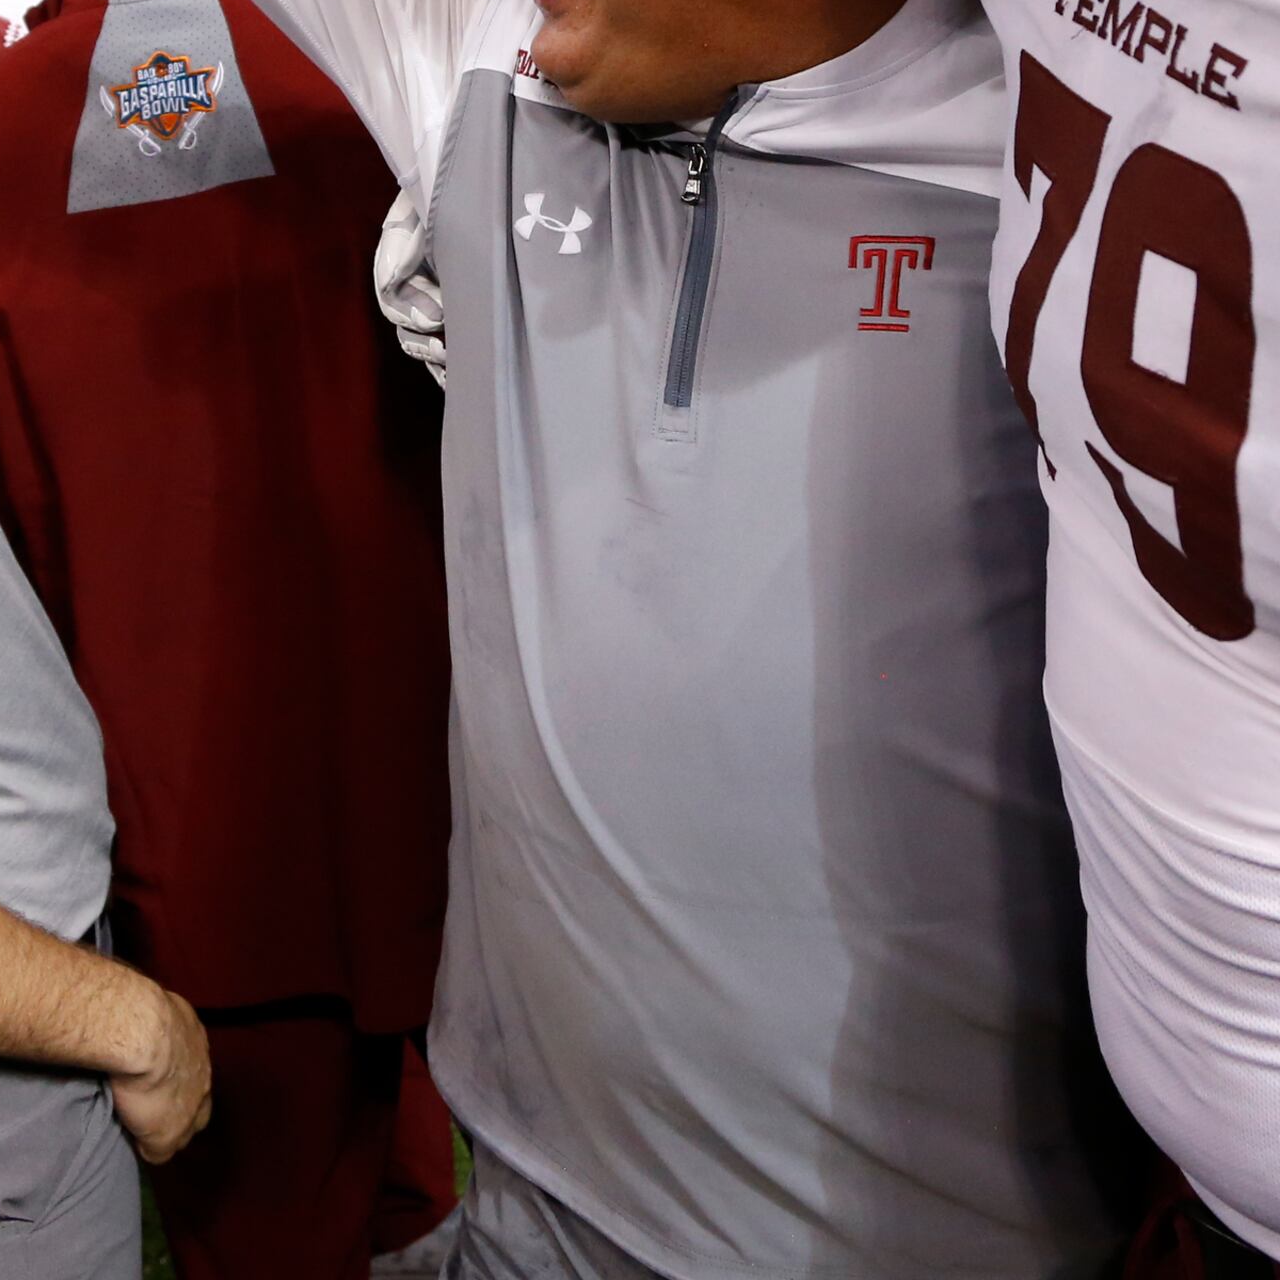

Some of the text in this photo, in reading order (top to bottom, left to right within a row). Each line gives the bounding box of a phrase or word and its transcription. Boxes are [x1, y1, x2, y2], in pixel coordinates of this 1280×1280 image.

[118, 73, 211, 118] GASPARILLA
[136, 66, 156, 81] BAD
[141, 97, 190, 120] BOWL
[847, 234, 937, 333] T
[1004, 47, 1257, 642] 79
